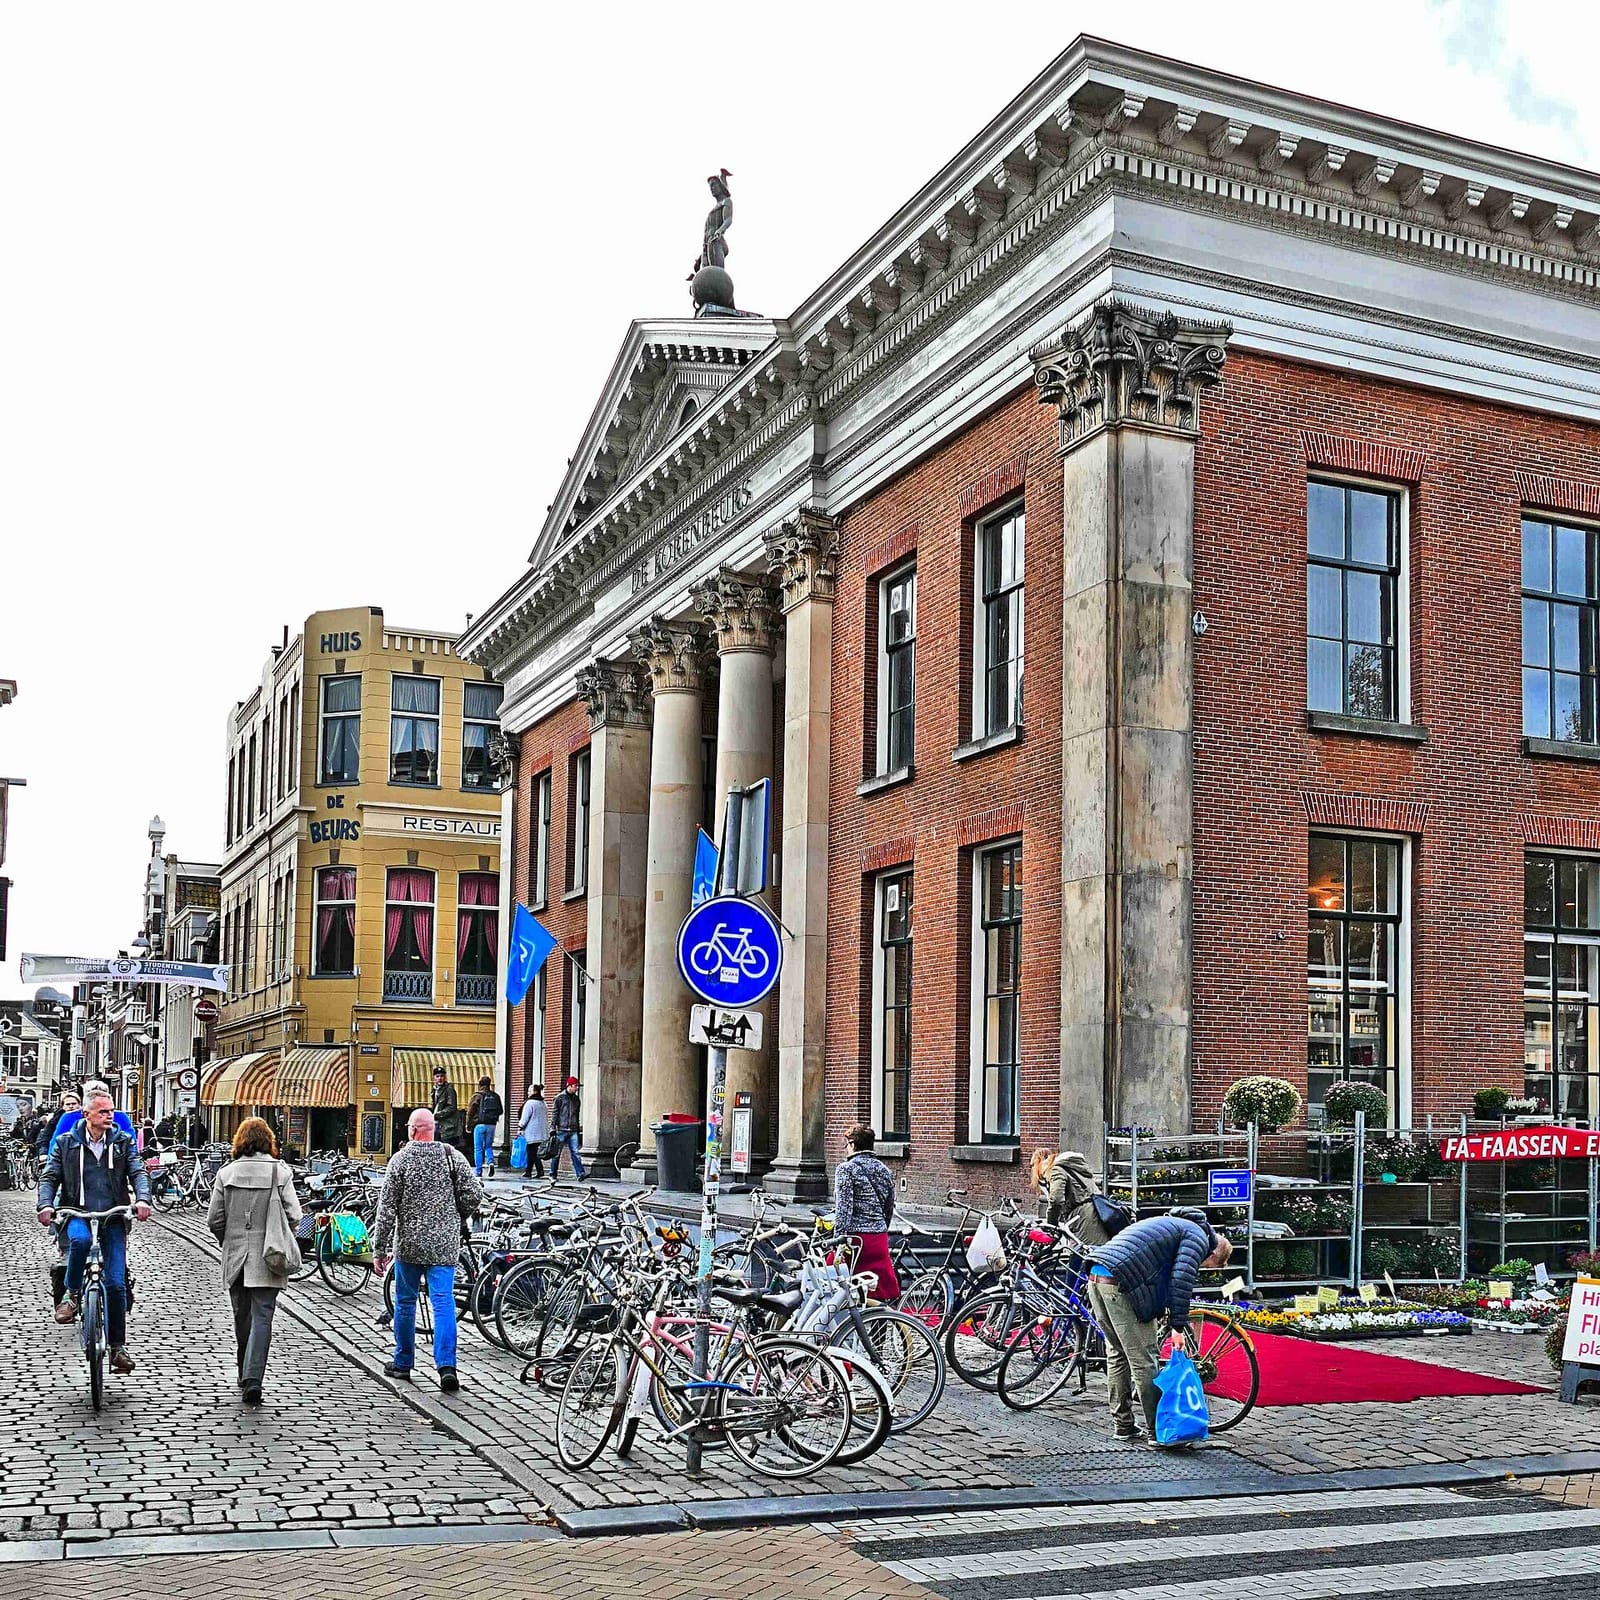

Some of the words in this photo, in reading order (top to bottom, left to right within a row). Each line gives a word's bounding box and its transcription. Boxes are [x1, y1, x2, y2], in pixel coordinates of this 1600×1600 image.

[631, 561, 649, 594] DE
[320, 631, 362, 653] HUIS
[326, 794, 345, 809] DE
[310, 818, 361, 844] BEURS
[65, 957, 106, 965] GRONINGER
[143, 961, 183, 970] STUDENTEN
[74, 964, 105, 972] CABARET
[143, 967, 174, 975] FESTIVAL
[1445, 1137, 1475, 1159] FA.
[1481, 1135, 1568, 1158] FAASSEN
[1210, 1186, 1240, 1197] PIN
